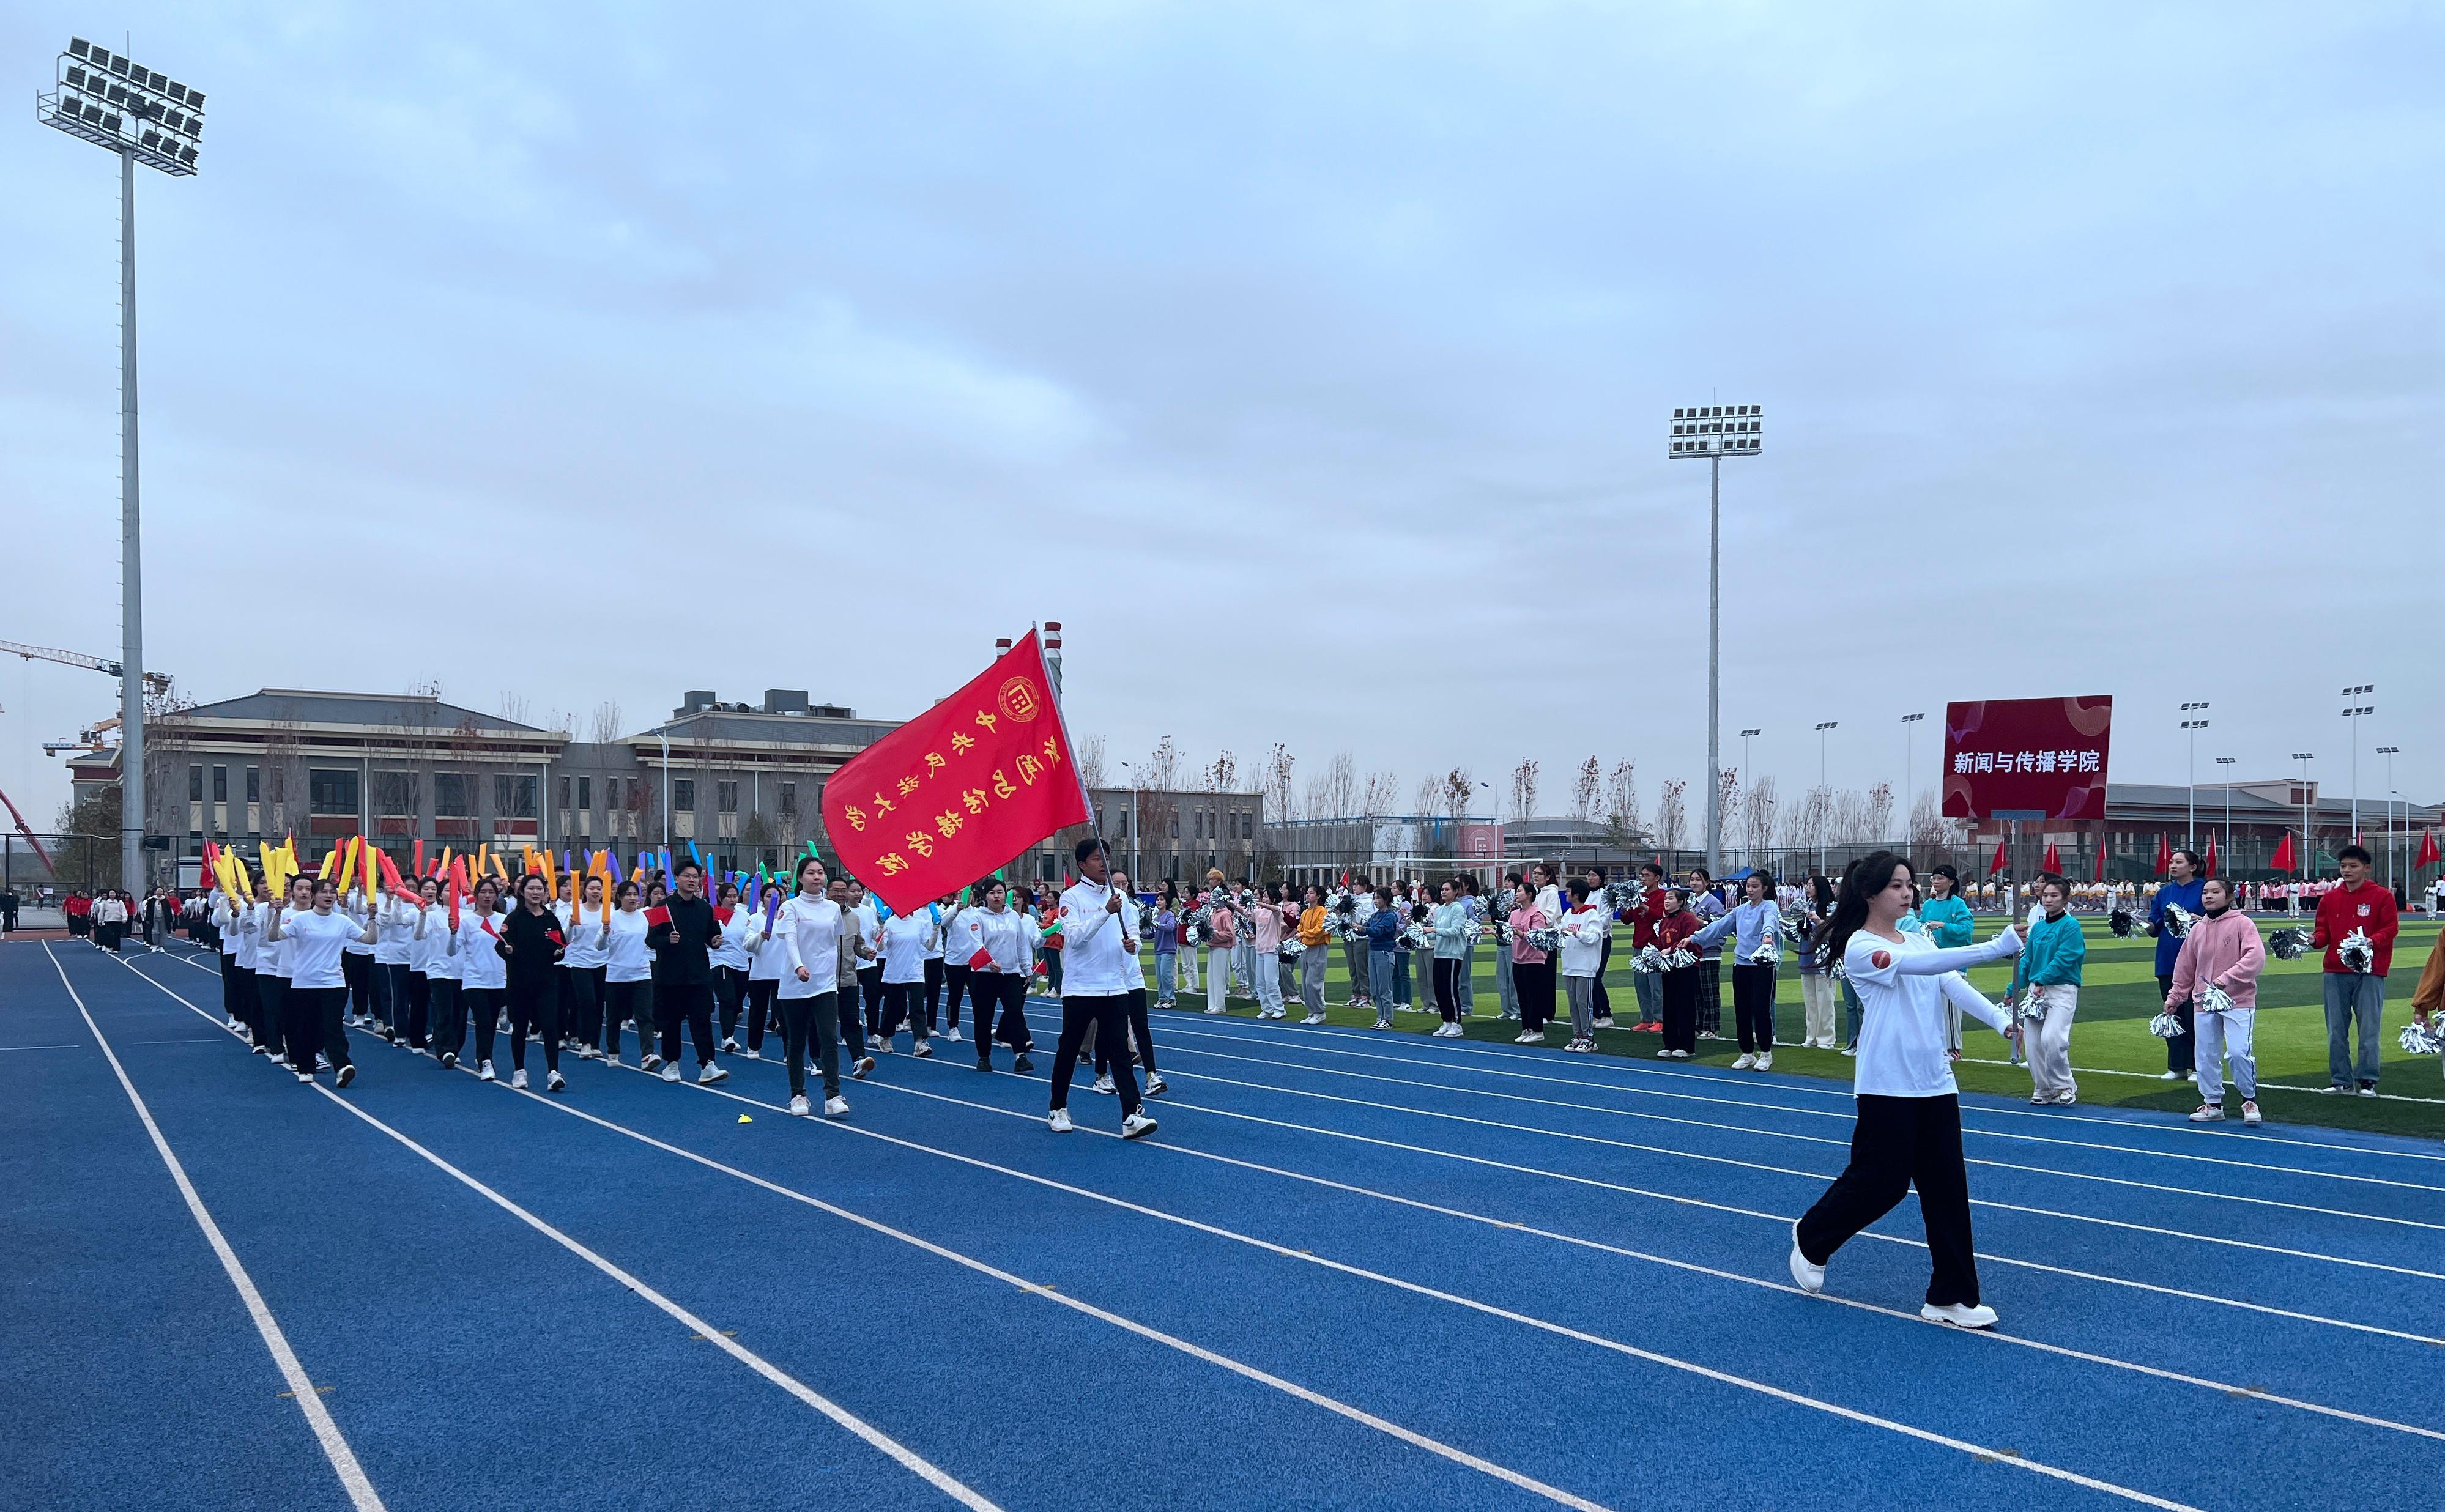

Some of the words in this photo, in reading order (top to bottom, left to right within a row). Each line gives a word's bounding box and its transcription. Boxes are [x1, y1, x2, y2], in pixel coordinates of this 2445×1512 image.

[1954, 749, 2100, 773] 新闻与传播学院
